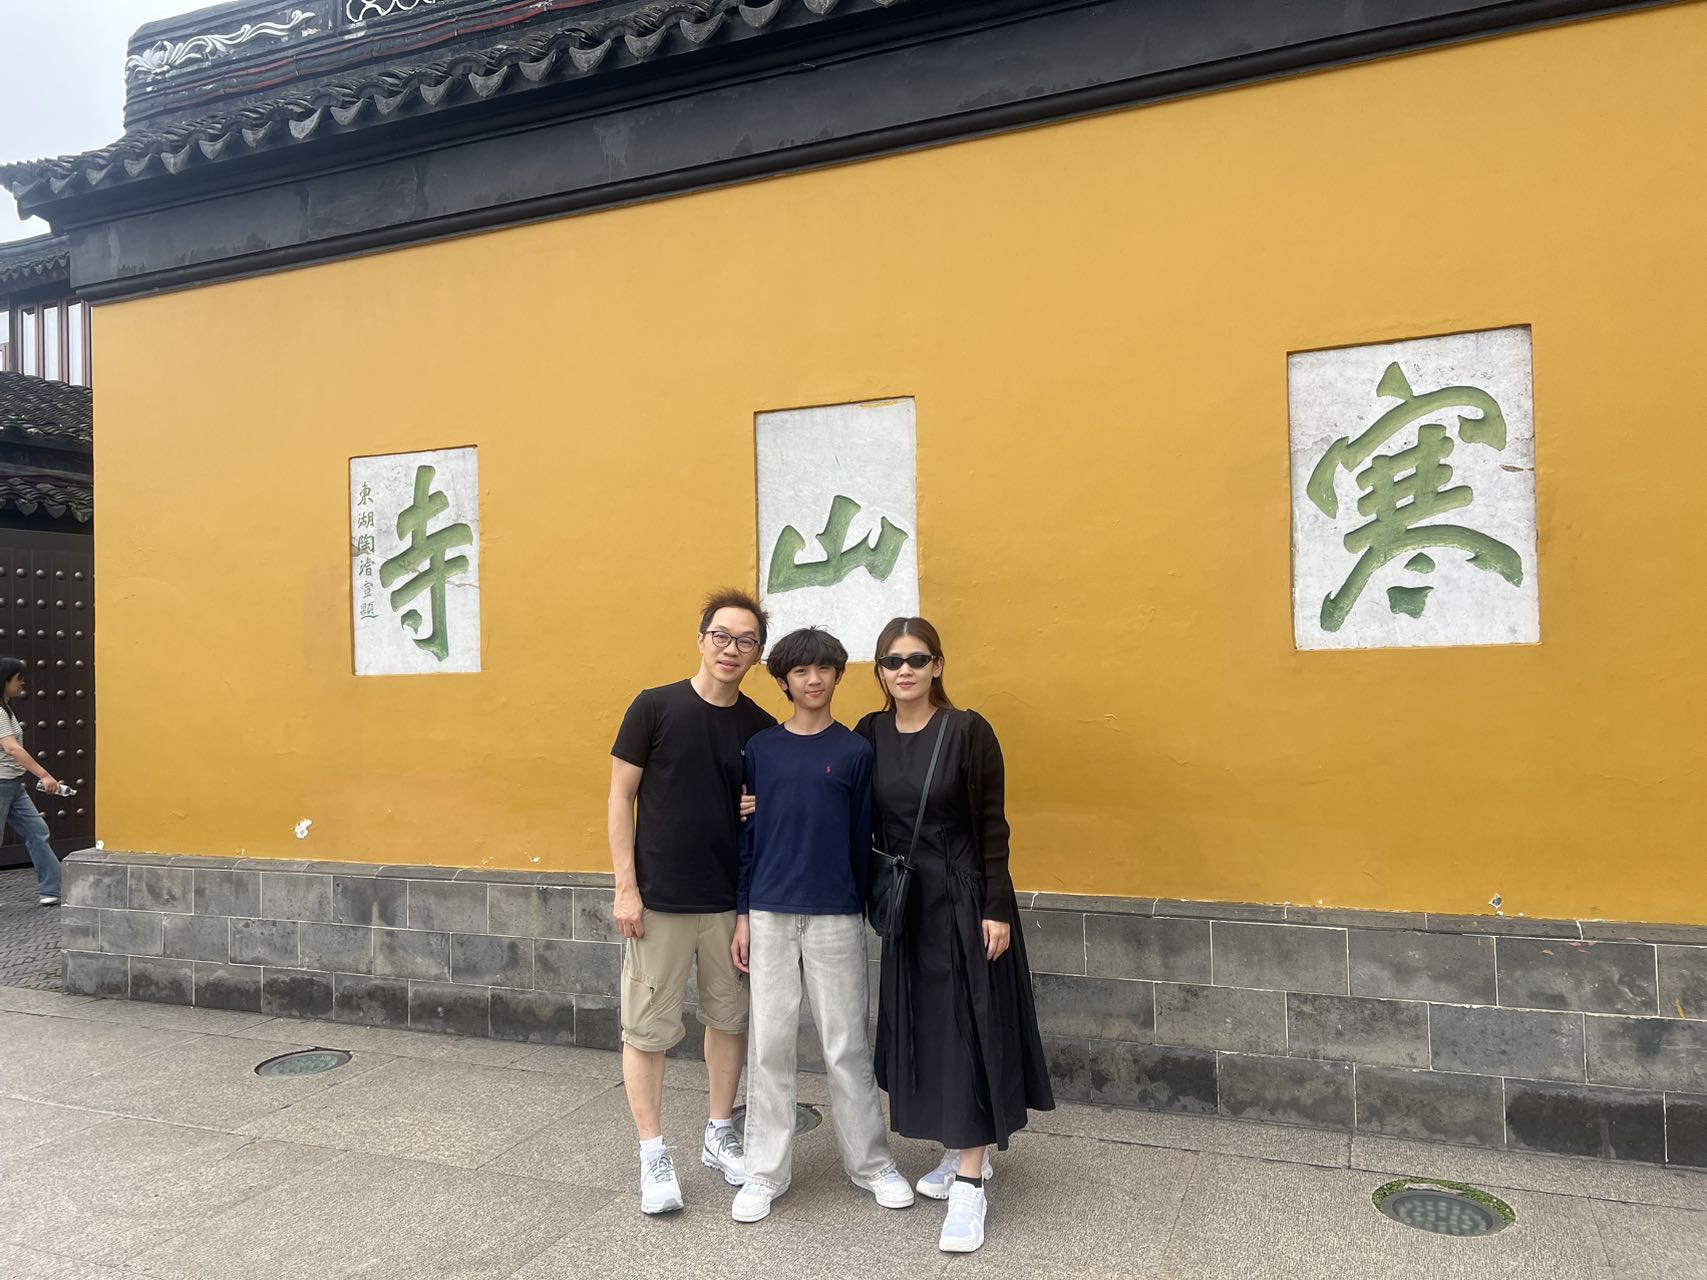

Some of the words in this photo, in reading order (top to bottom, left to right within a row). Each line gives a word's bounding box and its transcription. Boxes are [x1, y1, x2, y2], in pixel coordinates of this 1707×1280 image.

[379, 464, 474, 663] 寺
[767, 495, 909, 594] 山
[1306, 361, 1524, 632] 寒
